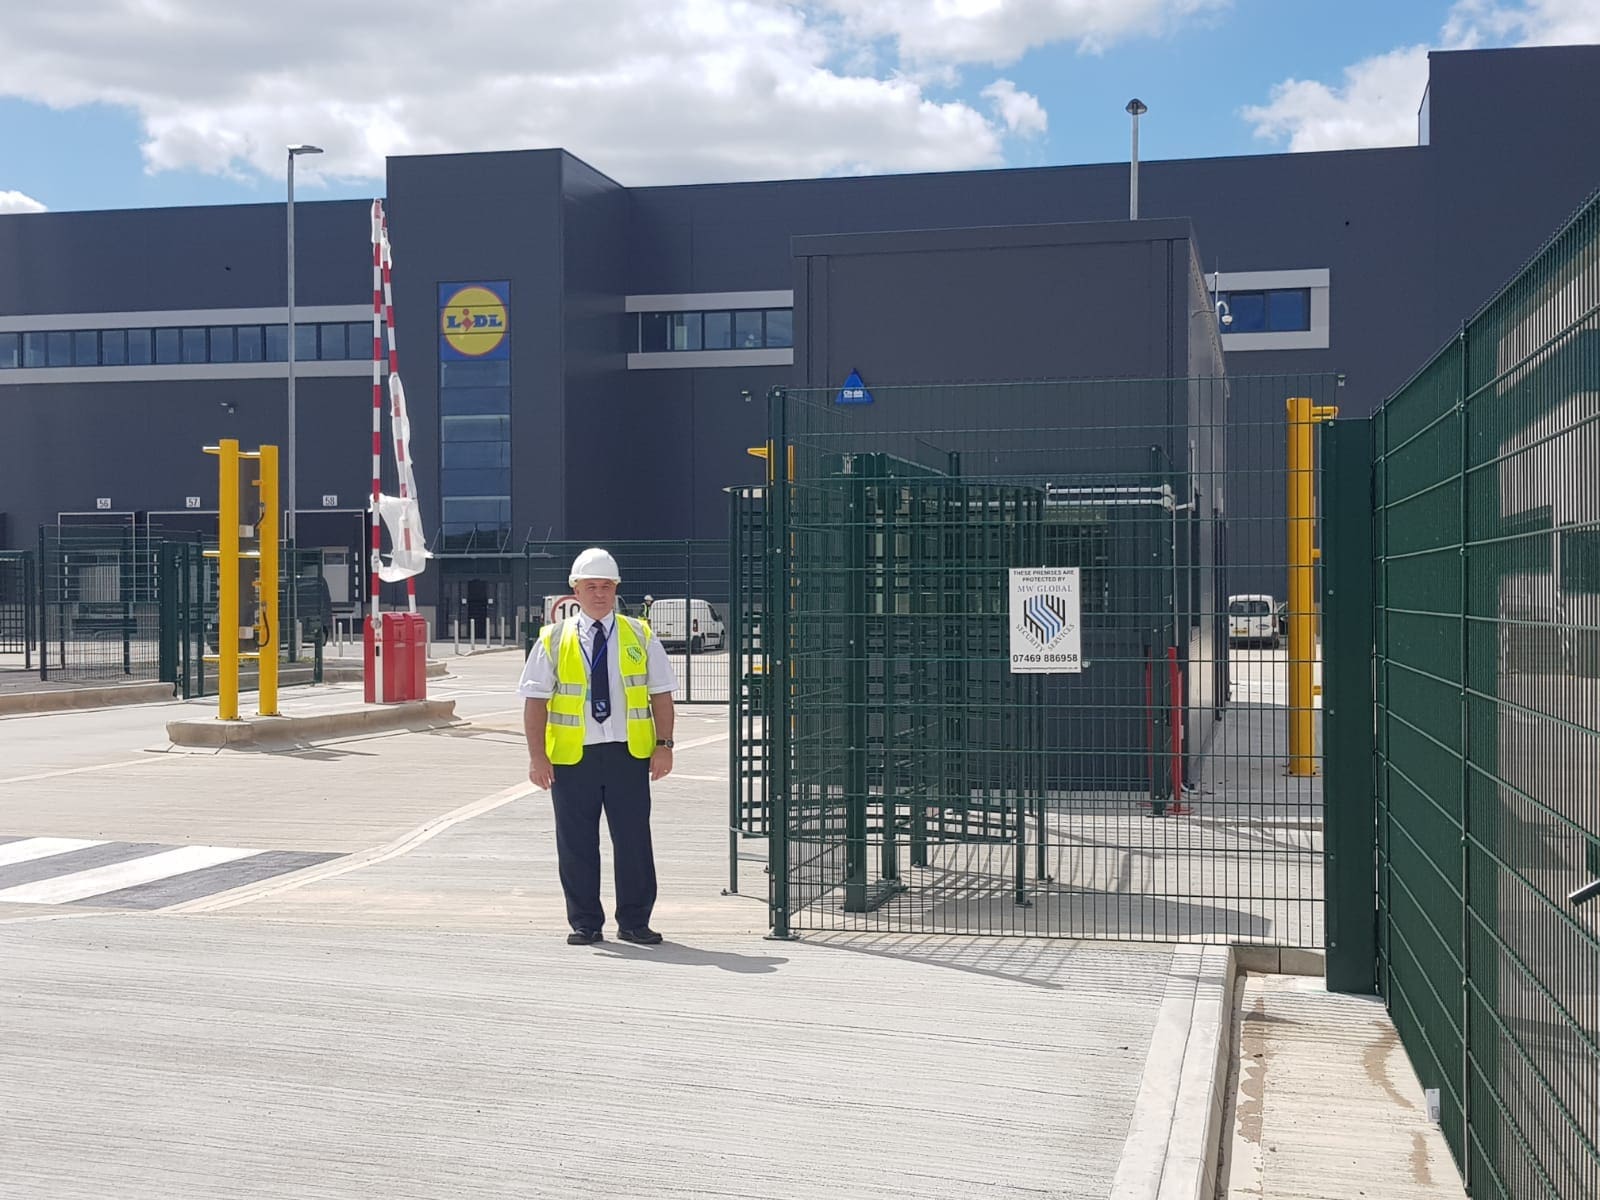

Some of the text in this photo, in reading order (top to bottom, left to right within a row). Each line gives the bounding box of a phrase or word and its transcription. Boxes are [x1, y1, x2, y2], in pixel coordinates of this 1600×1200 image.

[1017, 584, 1073, 593] MW GLOBAL
[1016, 623, 1044, 652] SECURITY
[1047, 623, 1075, 651] SERVICES
[1012, 653, 1078, 663] 07469 886958
